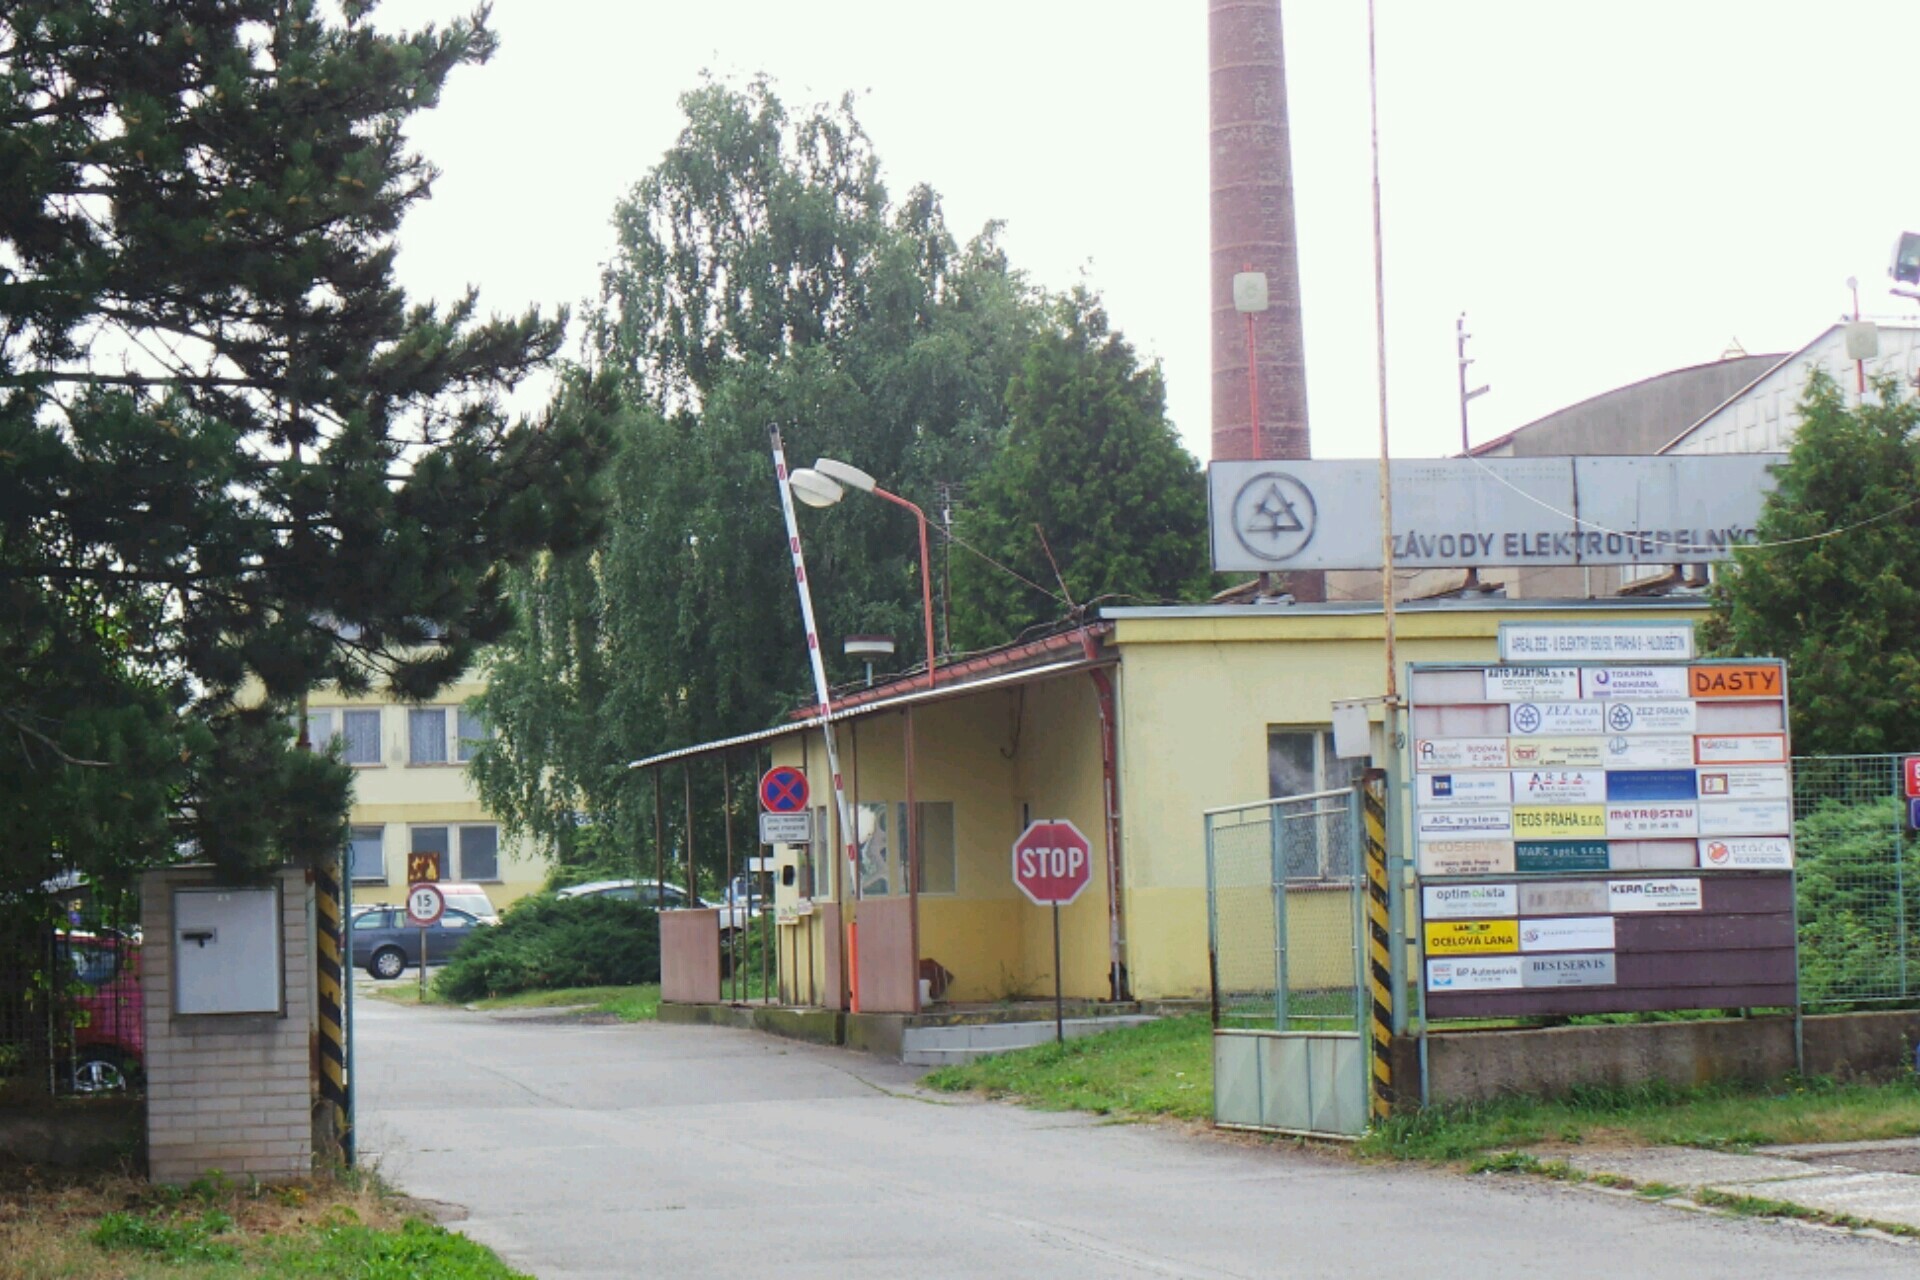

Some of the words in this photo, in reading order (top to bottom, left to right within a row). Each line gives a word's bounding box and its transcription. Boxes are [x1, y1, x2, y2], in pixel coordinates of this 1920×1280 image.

[1614, 635, 1637, 650] PRAHA
[1488, 668, 1510, 678] AUTO
[1512, 668, 1550, 678] MARTINA
[1696, 671, 1776, 692] DASTY
[1545, 705, 1572, 716] ZEZ
[1636, 707, 1656, 716] ZEZ
[1656, 706, 1690, 716] PRAHA
[1431, 815, 1453, 825] APL
[1515, 813, 1542, 827] TEOS
[1545, 813, 1580, 827] PRAHA
[1581, 814, 1604, 827] s.r.o.
[1022, 847, 1084, 878] STOP
[416, 894, 432, 907] 15
[1484, 935, 1513, 945] LANA
[1533, 958, 1606, 972] BESTSERVIS
